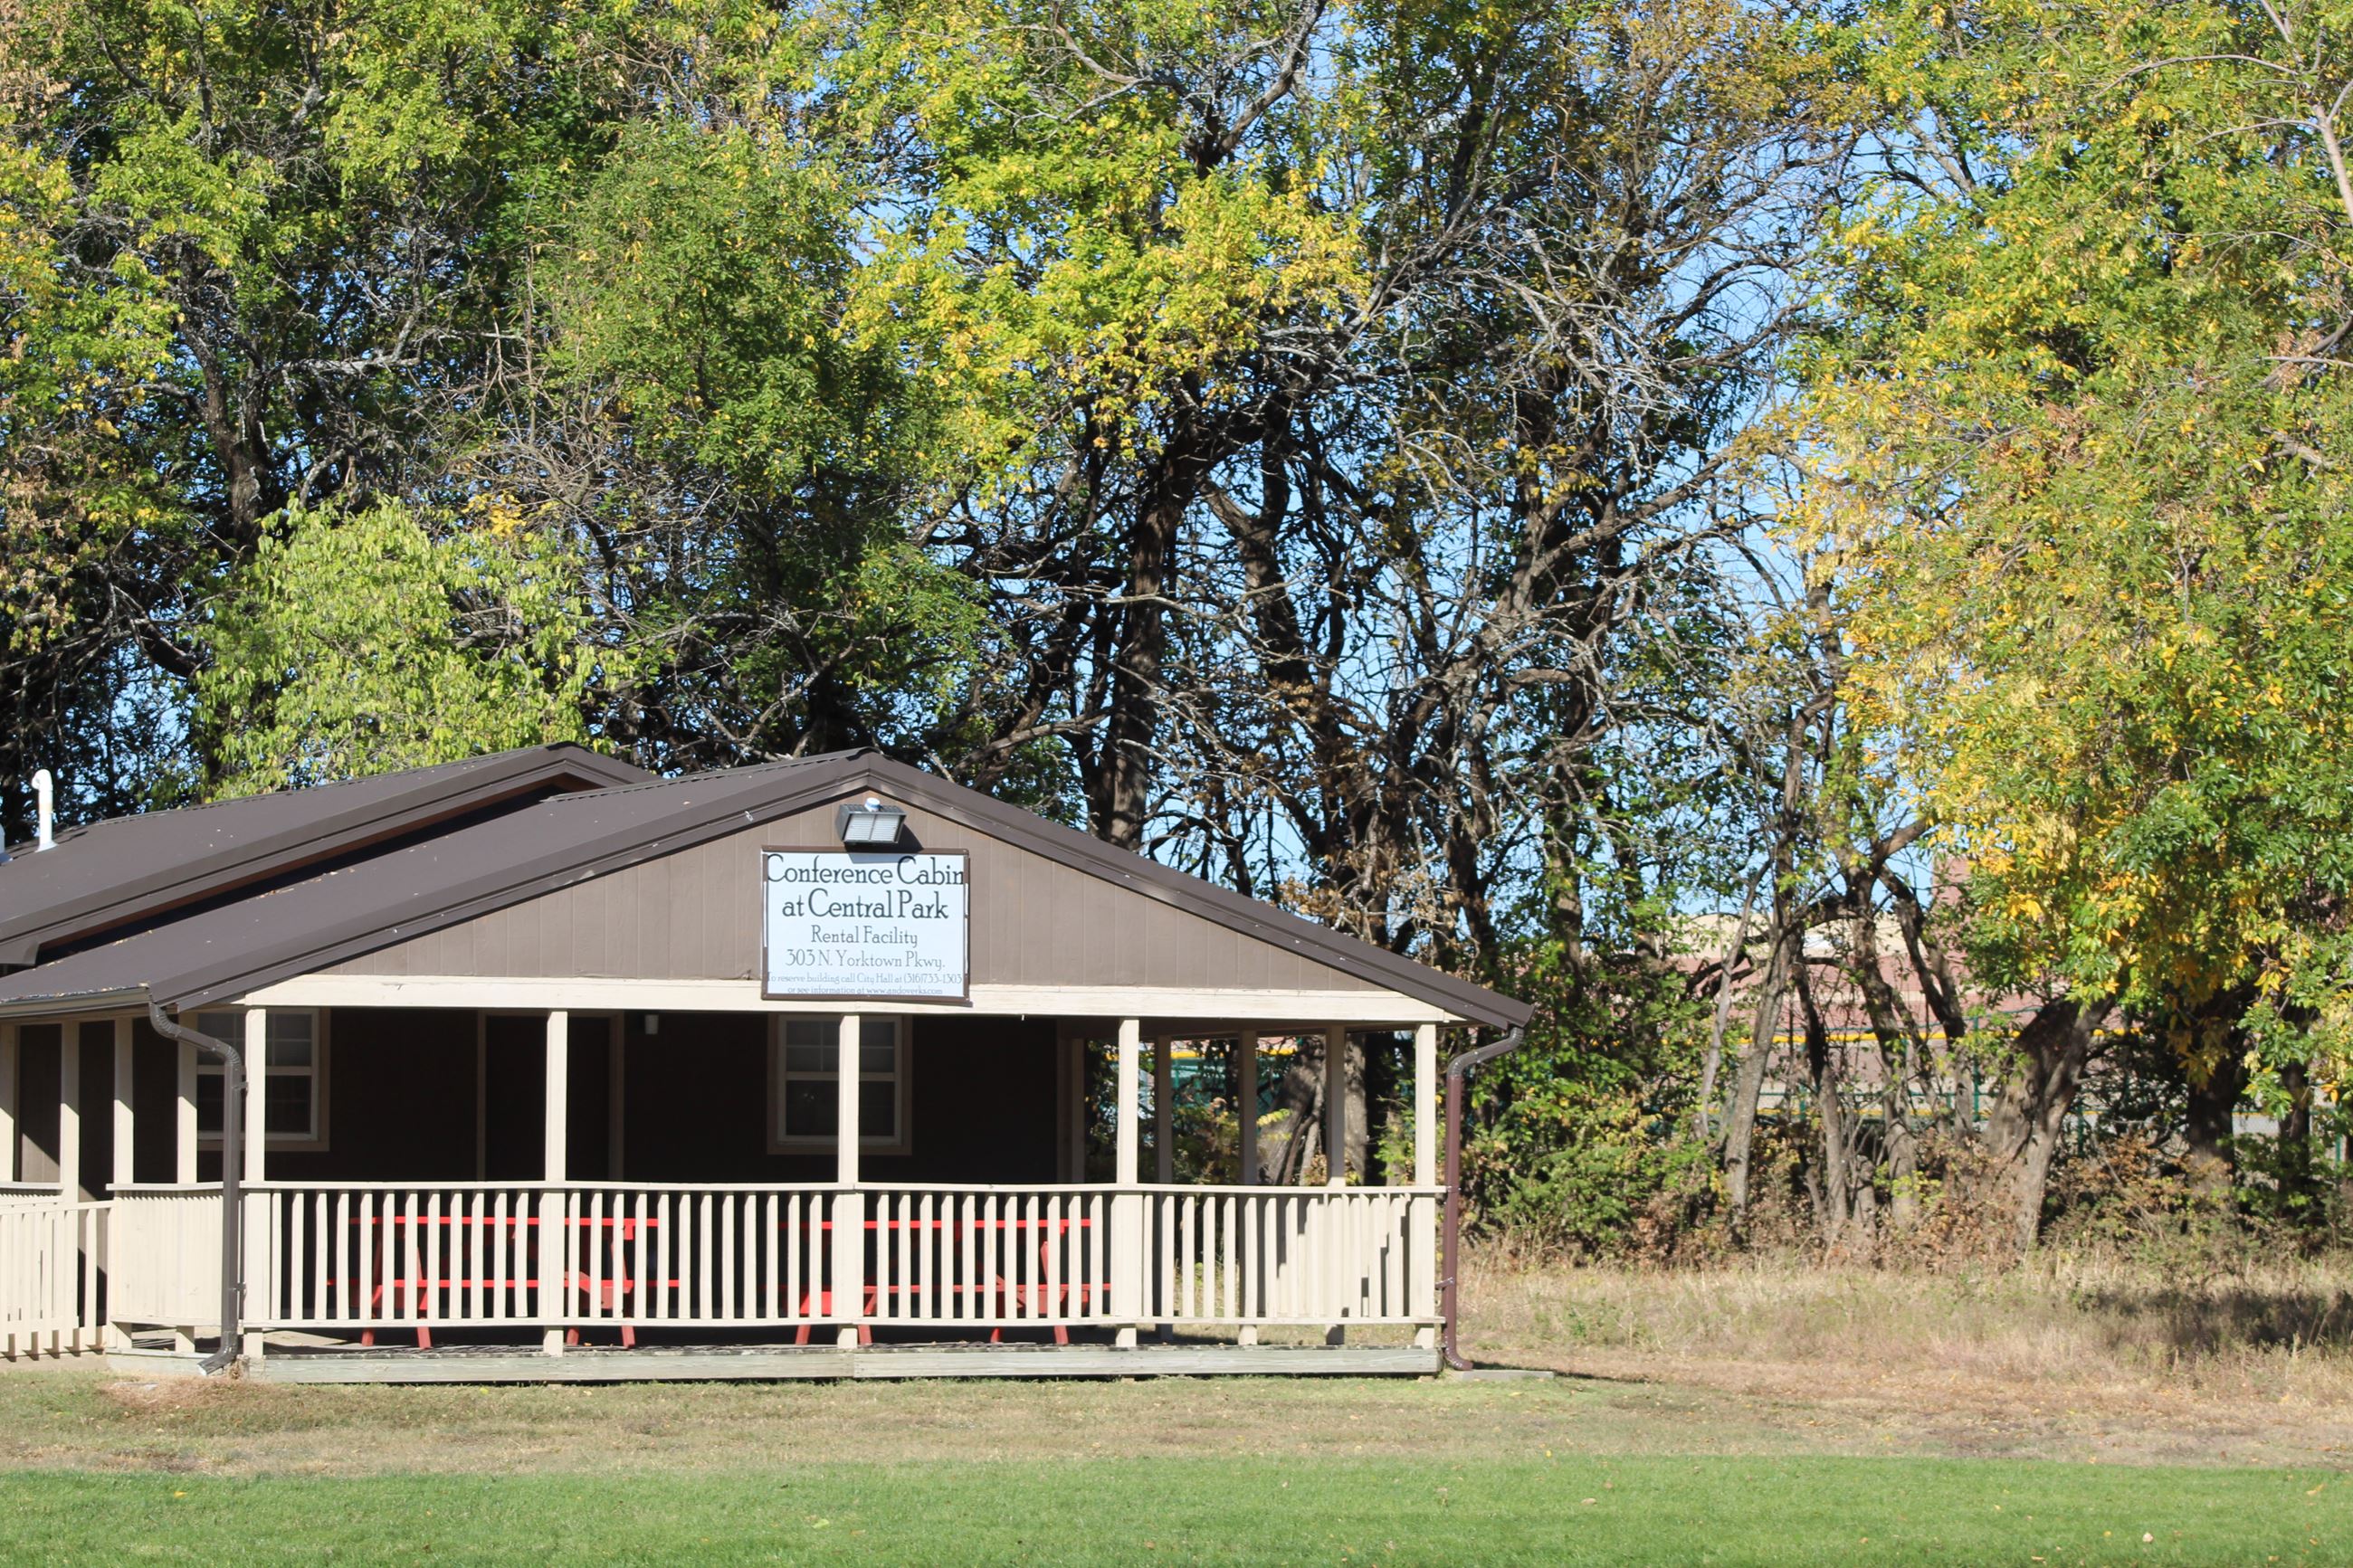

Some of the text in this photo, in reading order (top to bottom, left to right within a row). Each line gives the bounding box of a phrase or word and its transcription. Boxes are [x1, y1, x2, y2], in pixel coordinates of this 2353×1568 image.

[767, 853, 964, 885] Conference Cabin
[782, 888, 948, 919] at Central Park
[811, 925, 918, 948] Rental Facility
[786, 949, 946, 971] 303 N. Yorktown Pkwy.
[777, 974, 805, 983] reserve
[806, 972, 840, 984] building
[841, 973, 855, 983] call
[856, 973, 875, 984] City
[876, 973, 893, 984] Hall
[894, 974, 902, 984] at
[811, 984, 856, 994] information
[857, 986, 865, 994] at
